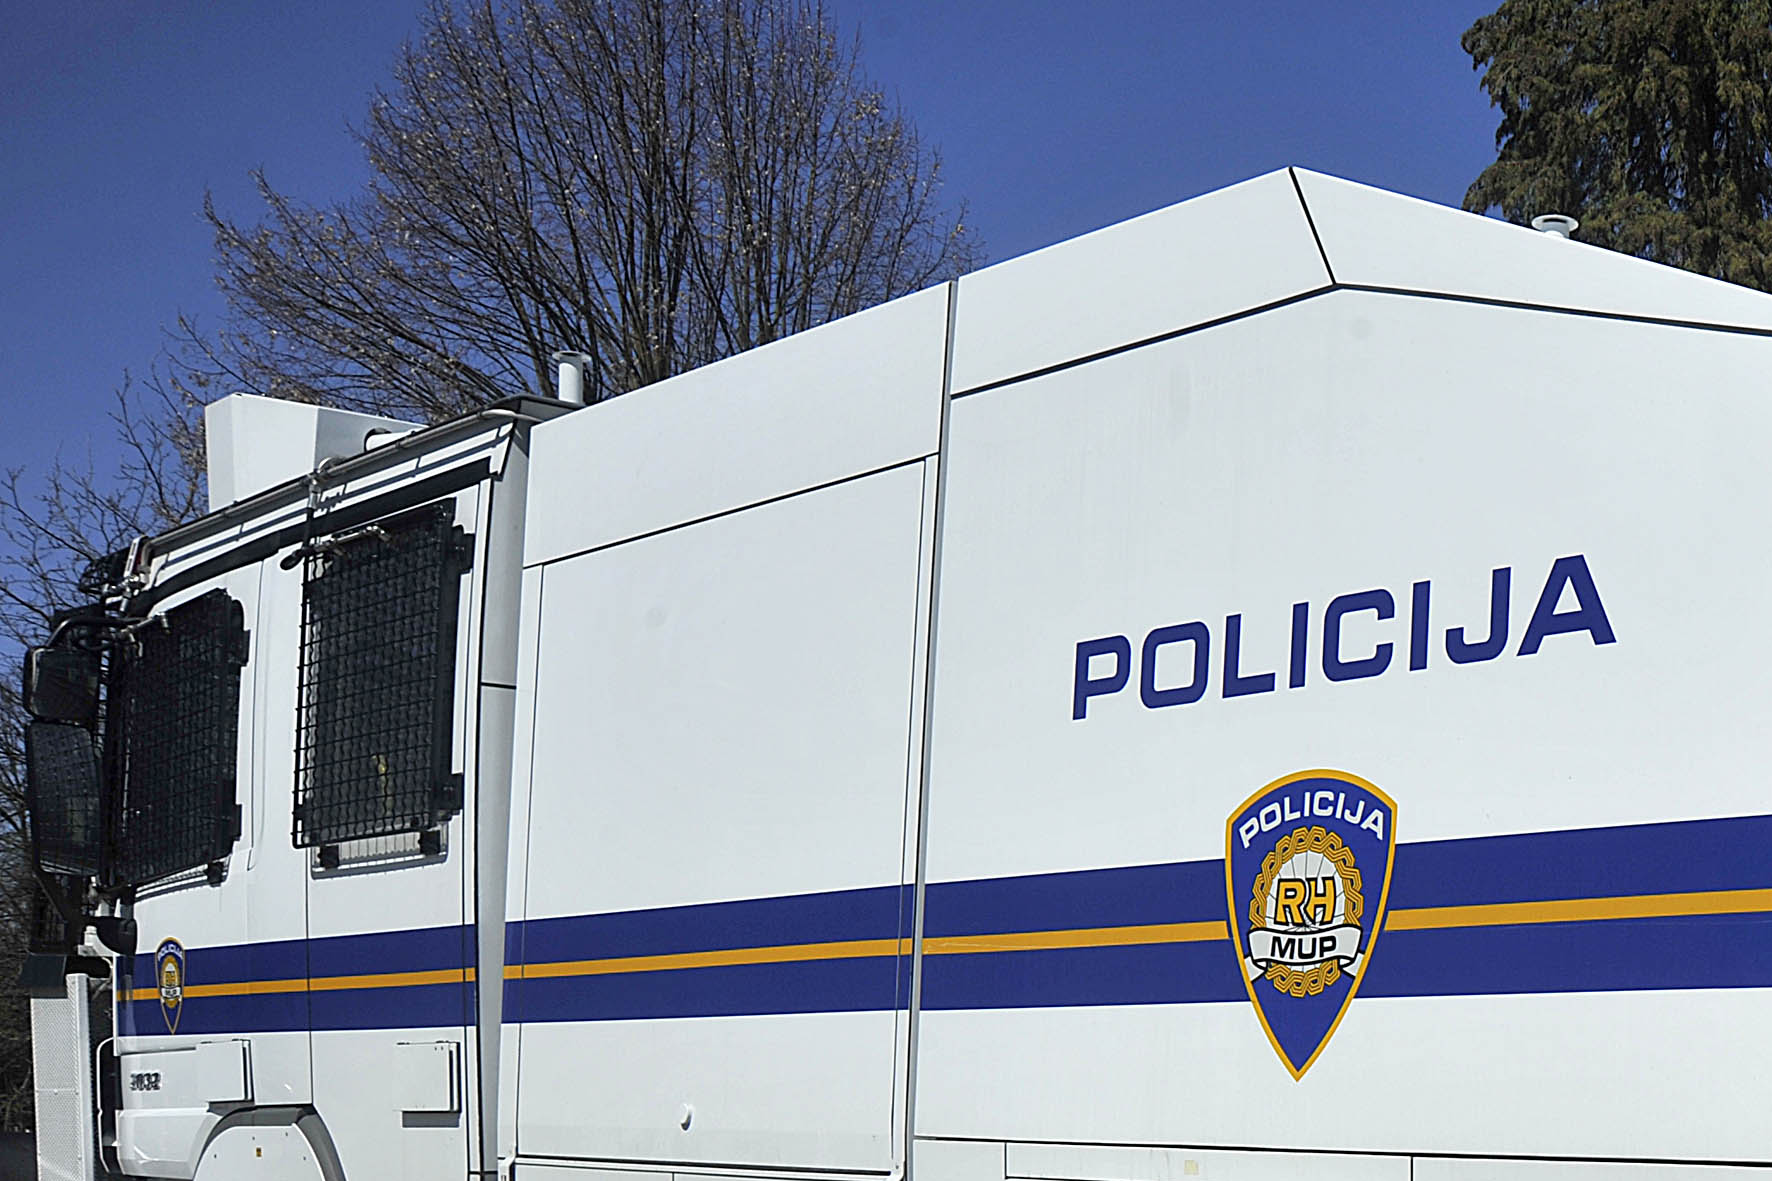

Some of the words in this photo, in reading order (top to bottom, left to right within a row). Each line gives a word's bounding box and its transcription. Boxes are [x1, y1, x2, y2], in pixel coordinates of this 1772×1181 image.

[1072, 554, 1616, 720] POLICIJA
[1238, 790, 1384, 849] POLICIJA
[1276, 876, 1337, 926] RH
[1270, 934, 1338, 960] MUP
